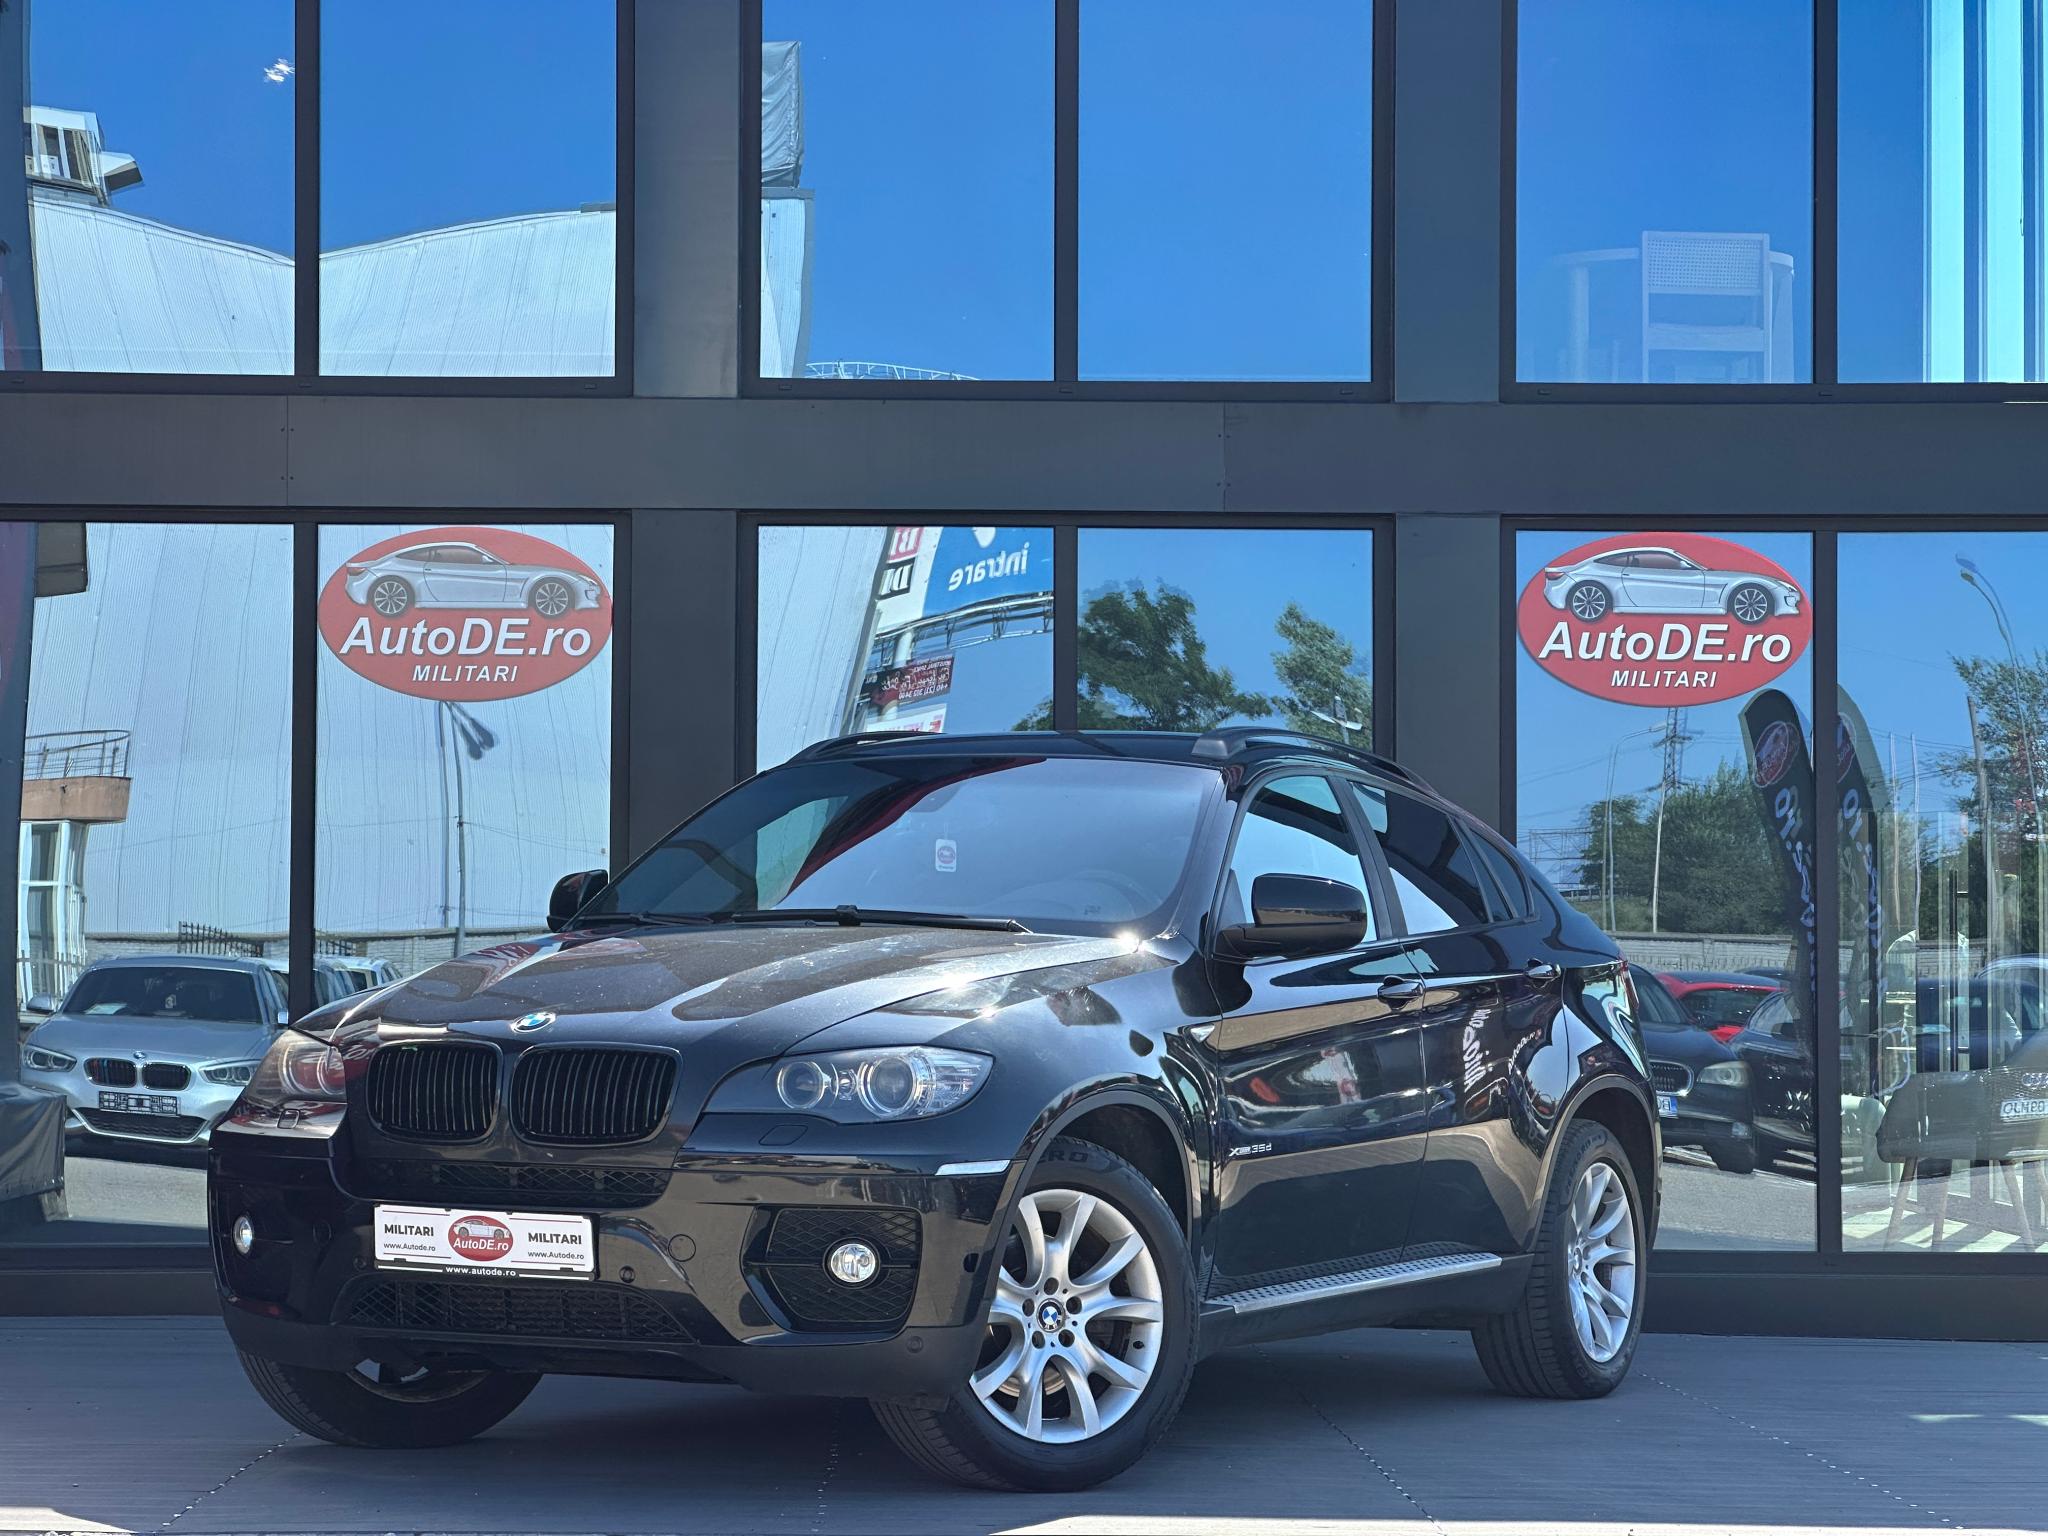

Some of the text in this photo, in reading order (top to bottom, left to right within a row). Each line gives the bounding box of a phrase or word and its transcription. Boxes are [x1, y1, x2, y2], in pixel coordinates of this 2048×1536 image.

[340, 616, 592, 657] AutoDE.ro
[1538, 621, 1792, 663] AutoDE.ro
[412, 664, 518, 683] MILITARI
[1610, 670, 1717, 688] MILITARI
[384, 1223, 434, 1237] MILITARI
[453, 1238, 509, 1252] AutoDE.ro
[528, 1232, 582, 1245] MILITARI
[383, 1242, 436, 1252] www.Autode.ro
[527, 1250, 585, 1260] www.Autode.ro
[445, 1265, 517, 1277] www.autode.ro
